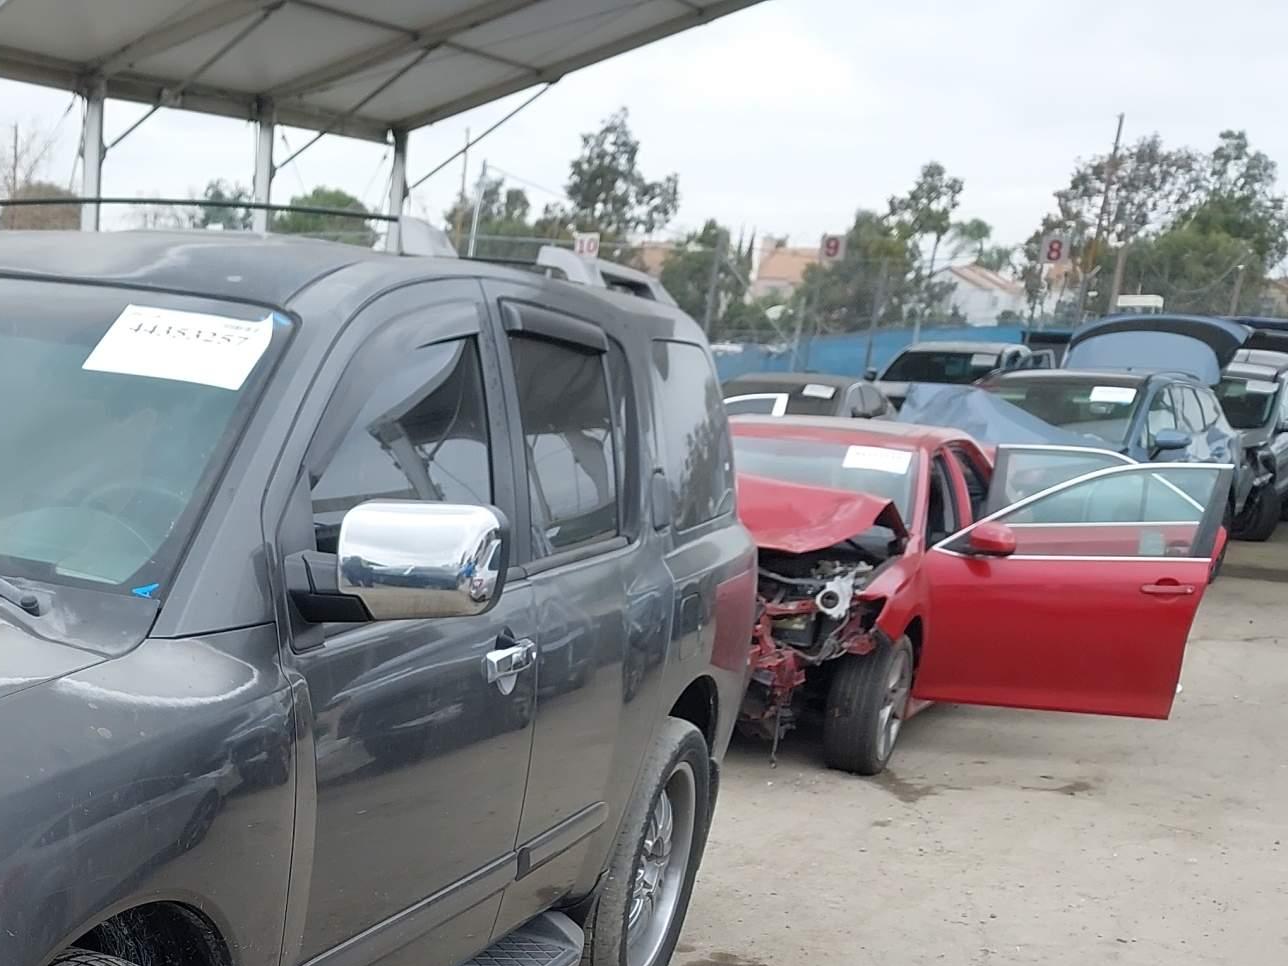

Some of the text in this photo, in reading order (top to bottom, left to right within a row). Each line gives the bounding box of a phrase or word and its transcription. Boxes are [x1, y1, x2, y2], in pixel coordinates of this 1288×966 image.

[578, 238, 598, 255] 10
[825, 237, 840, 257] 9
[1047, 240, 1063, 261] 8
